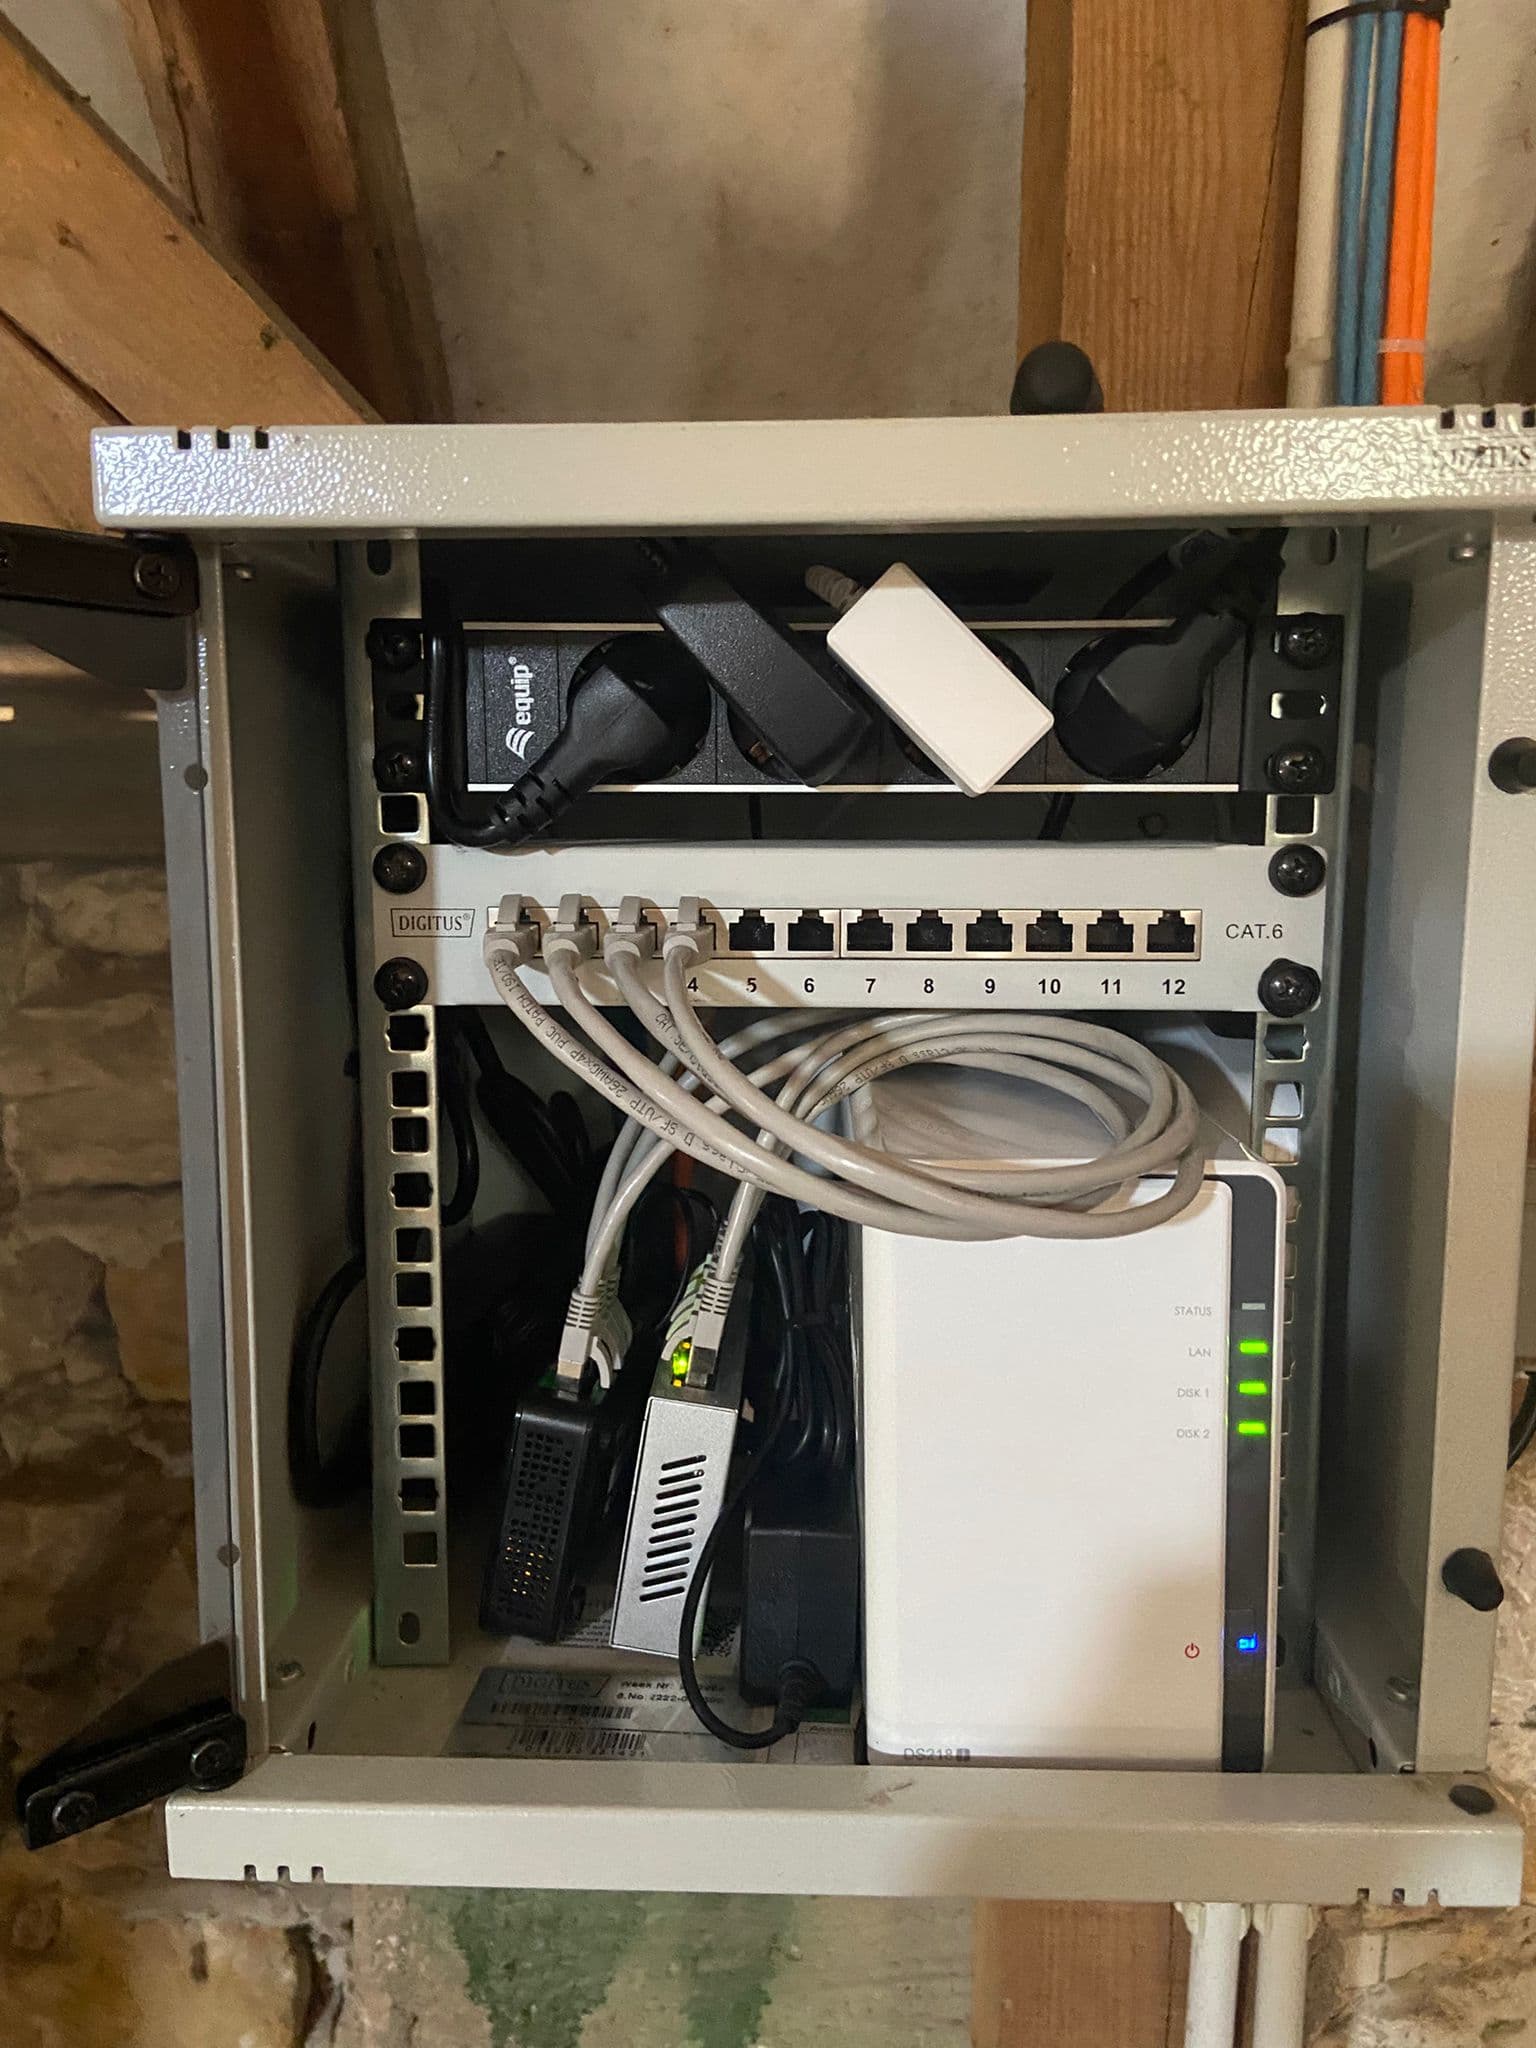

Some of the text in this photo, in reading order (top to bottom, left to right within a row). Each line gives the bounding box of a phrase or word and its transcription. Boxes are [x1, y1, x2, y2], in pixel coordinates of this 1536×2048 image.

[510, 664, 535, 725] equip
[399, 914, 463, 931] DIGITUS
[1225, 923, 1284, 940] CAT.6
[686, 977, 698, 993] 4
[746, 977, 757, 993] 5
[804, 977, 815, 993] 6
[865, 978, 876, 994] 7
[923, 978, 934, 994] 8
[984, 978, 996, 994] 9
[1038, 978, 1061, 995] 10
[1101, 978, 1121, 995] 11
[1162, 978, 1186, 995] 12
[1174, 1306, 1212, 1317] STATUS
[1188, 1347, 1212, 1358] LAN
[1177, 1388, 1201, 1399] DISK
[1176, 1429, 1210, 1440] DISK 2
